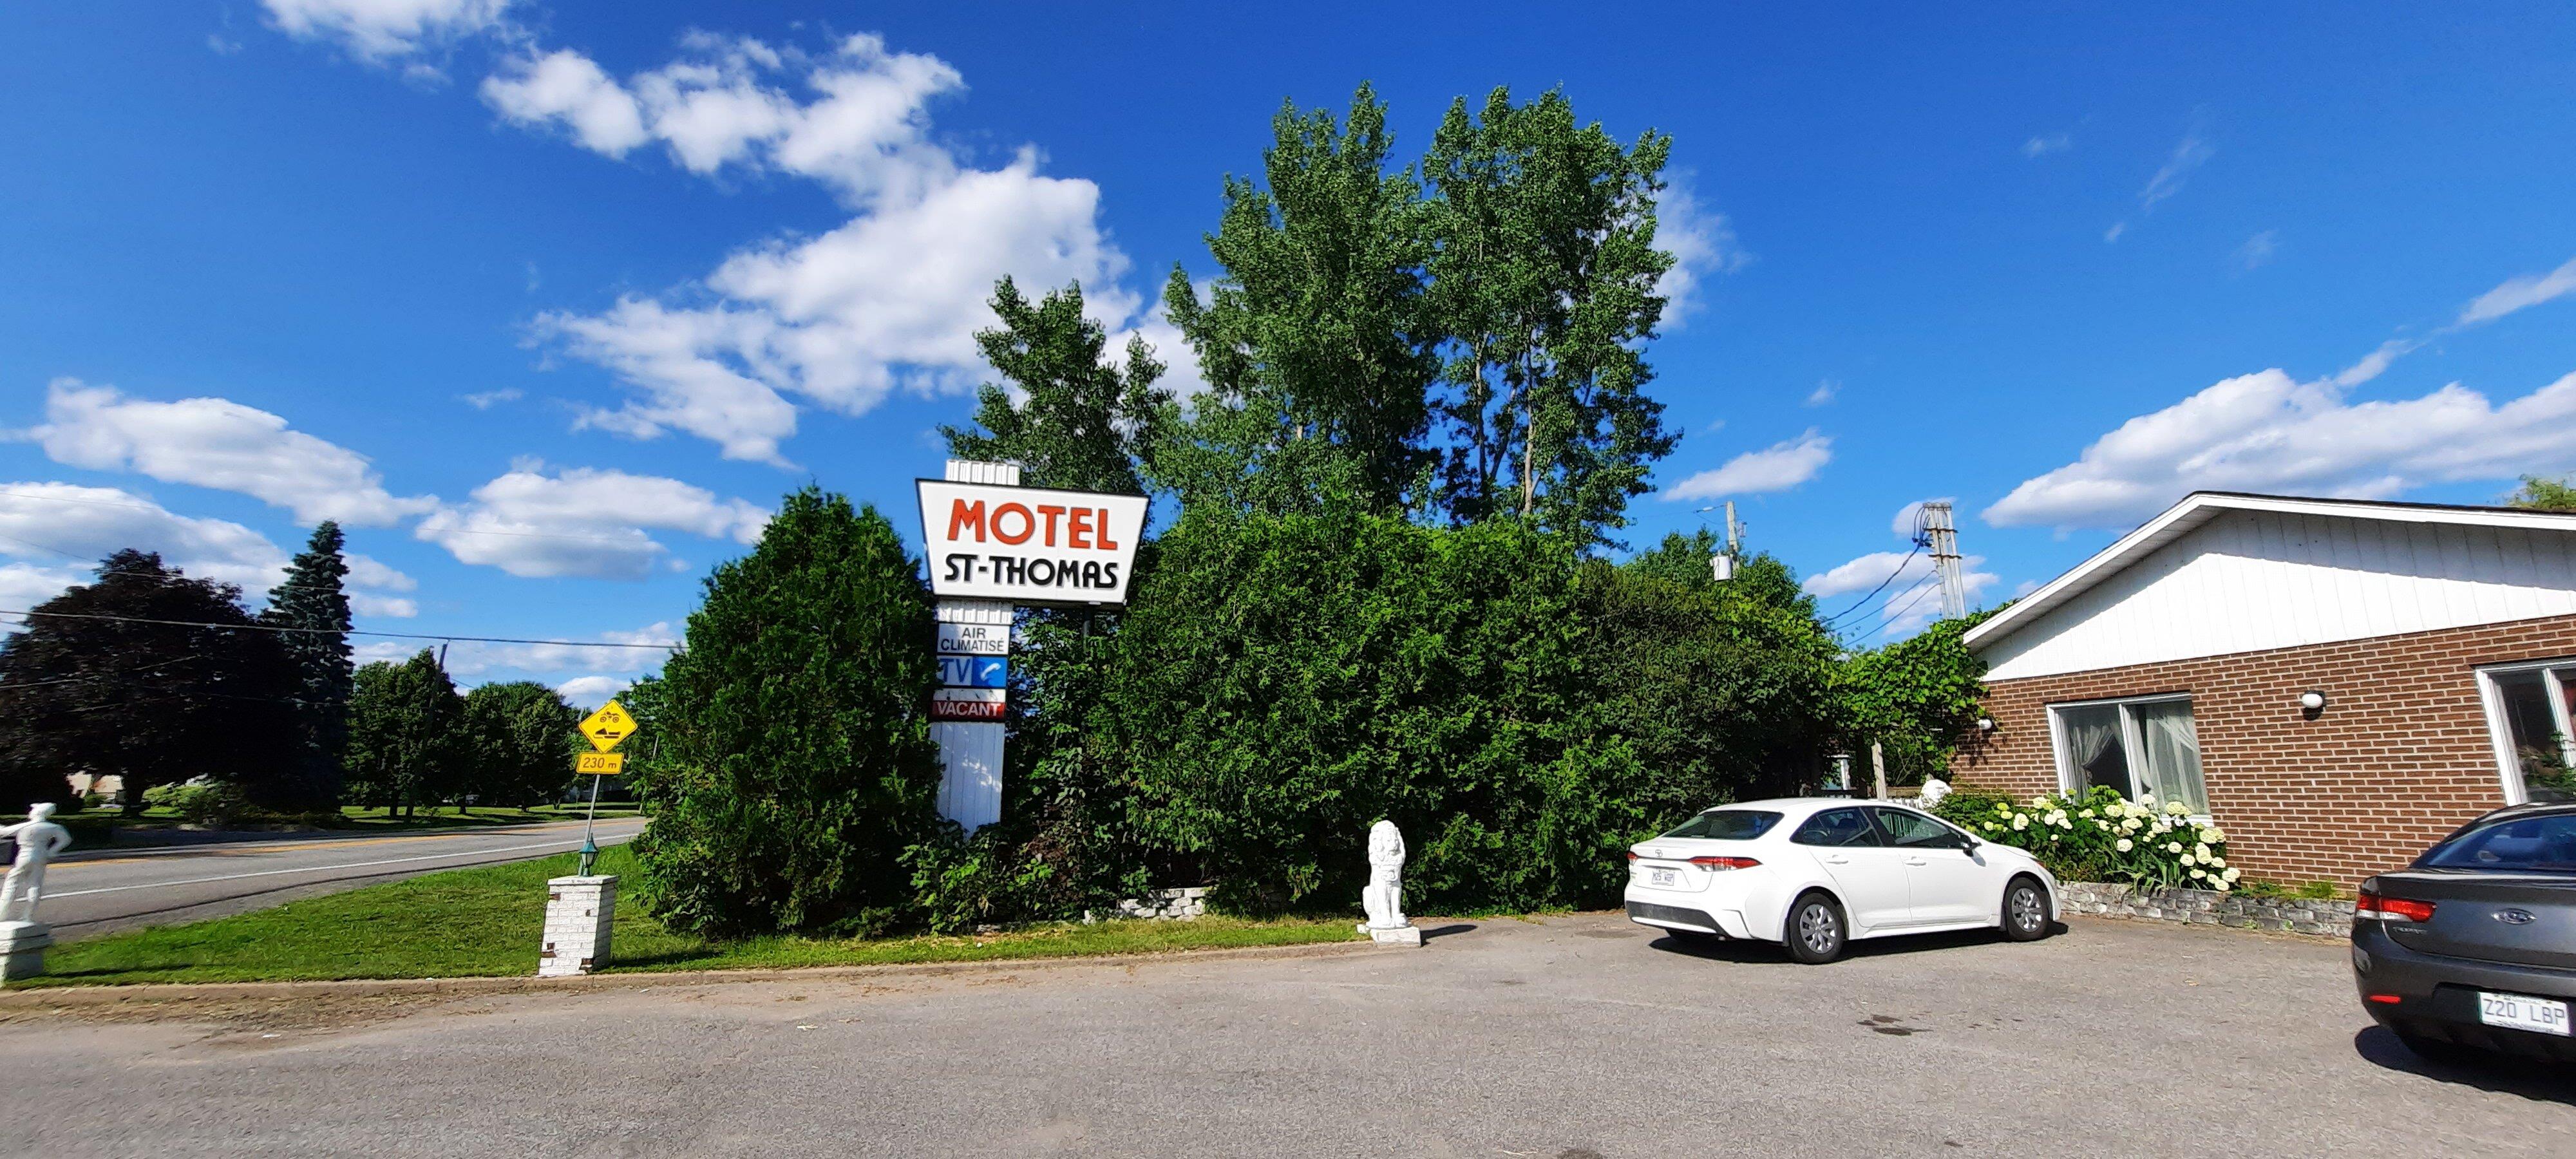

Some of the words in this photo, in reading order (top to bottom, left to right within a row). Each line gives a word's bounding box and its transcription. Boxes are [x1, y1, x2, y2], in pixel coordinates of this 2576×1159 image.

[947, 498, 1118, 551] MOTEL
[944, 553, 1119, 589] ST-THOMAS
[961, 627, 987, 639] AIR
[941, 637, 1005, 652] CLIMATISÉ
[939, 658, 971, 683] TV
[937, 701, 1001, 717] VACANT
[583, 757, 605, 768] 230
[2483, 998, 2517, 1018] Z20
[2530, 1004, 2565, 1025] LBP
